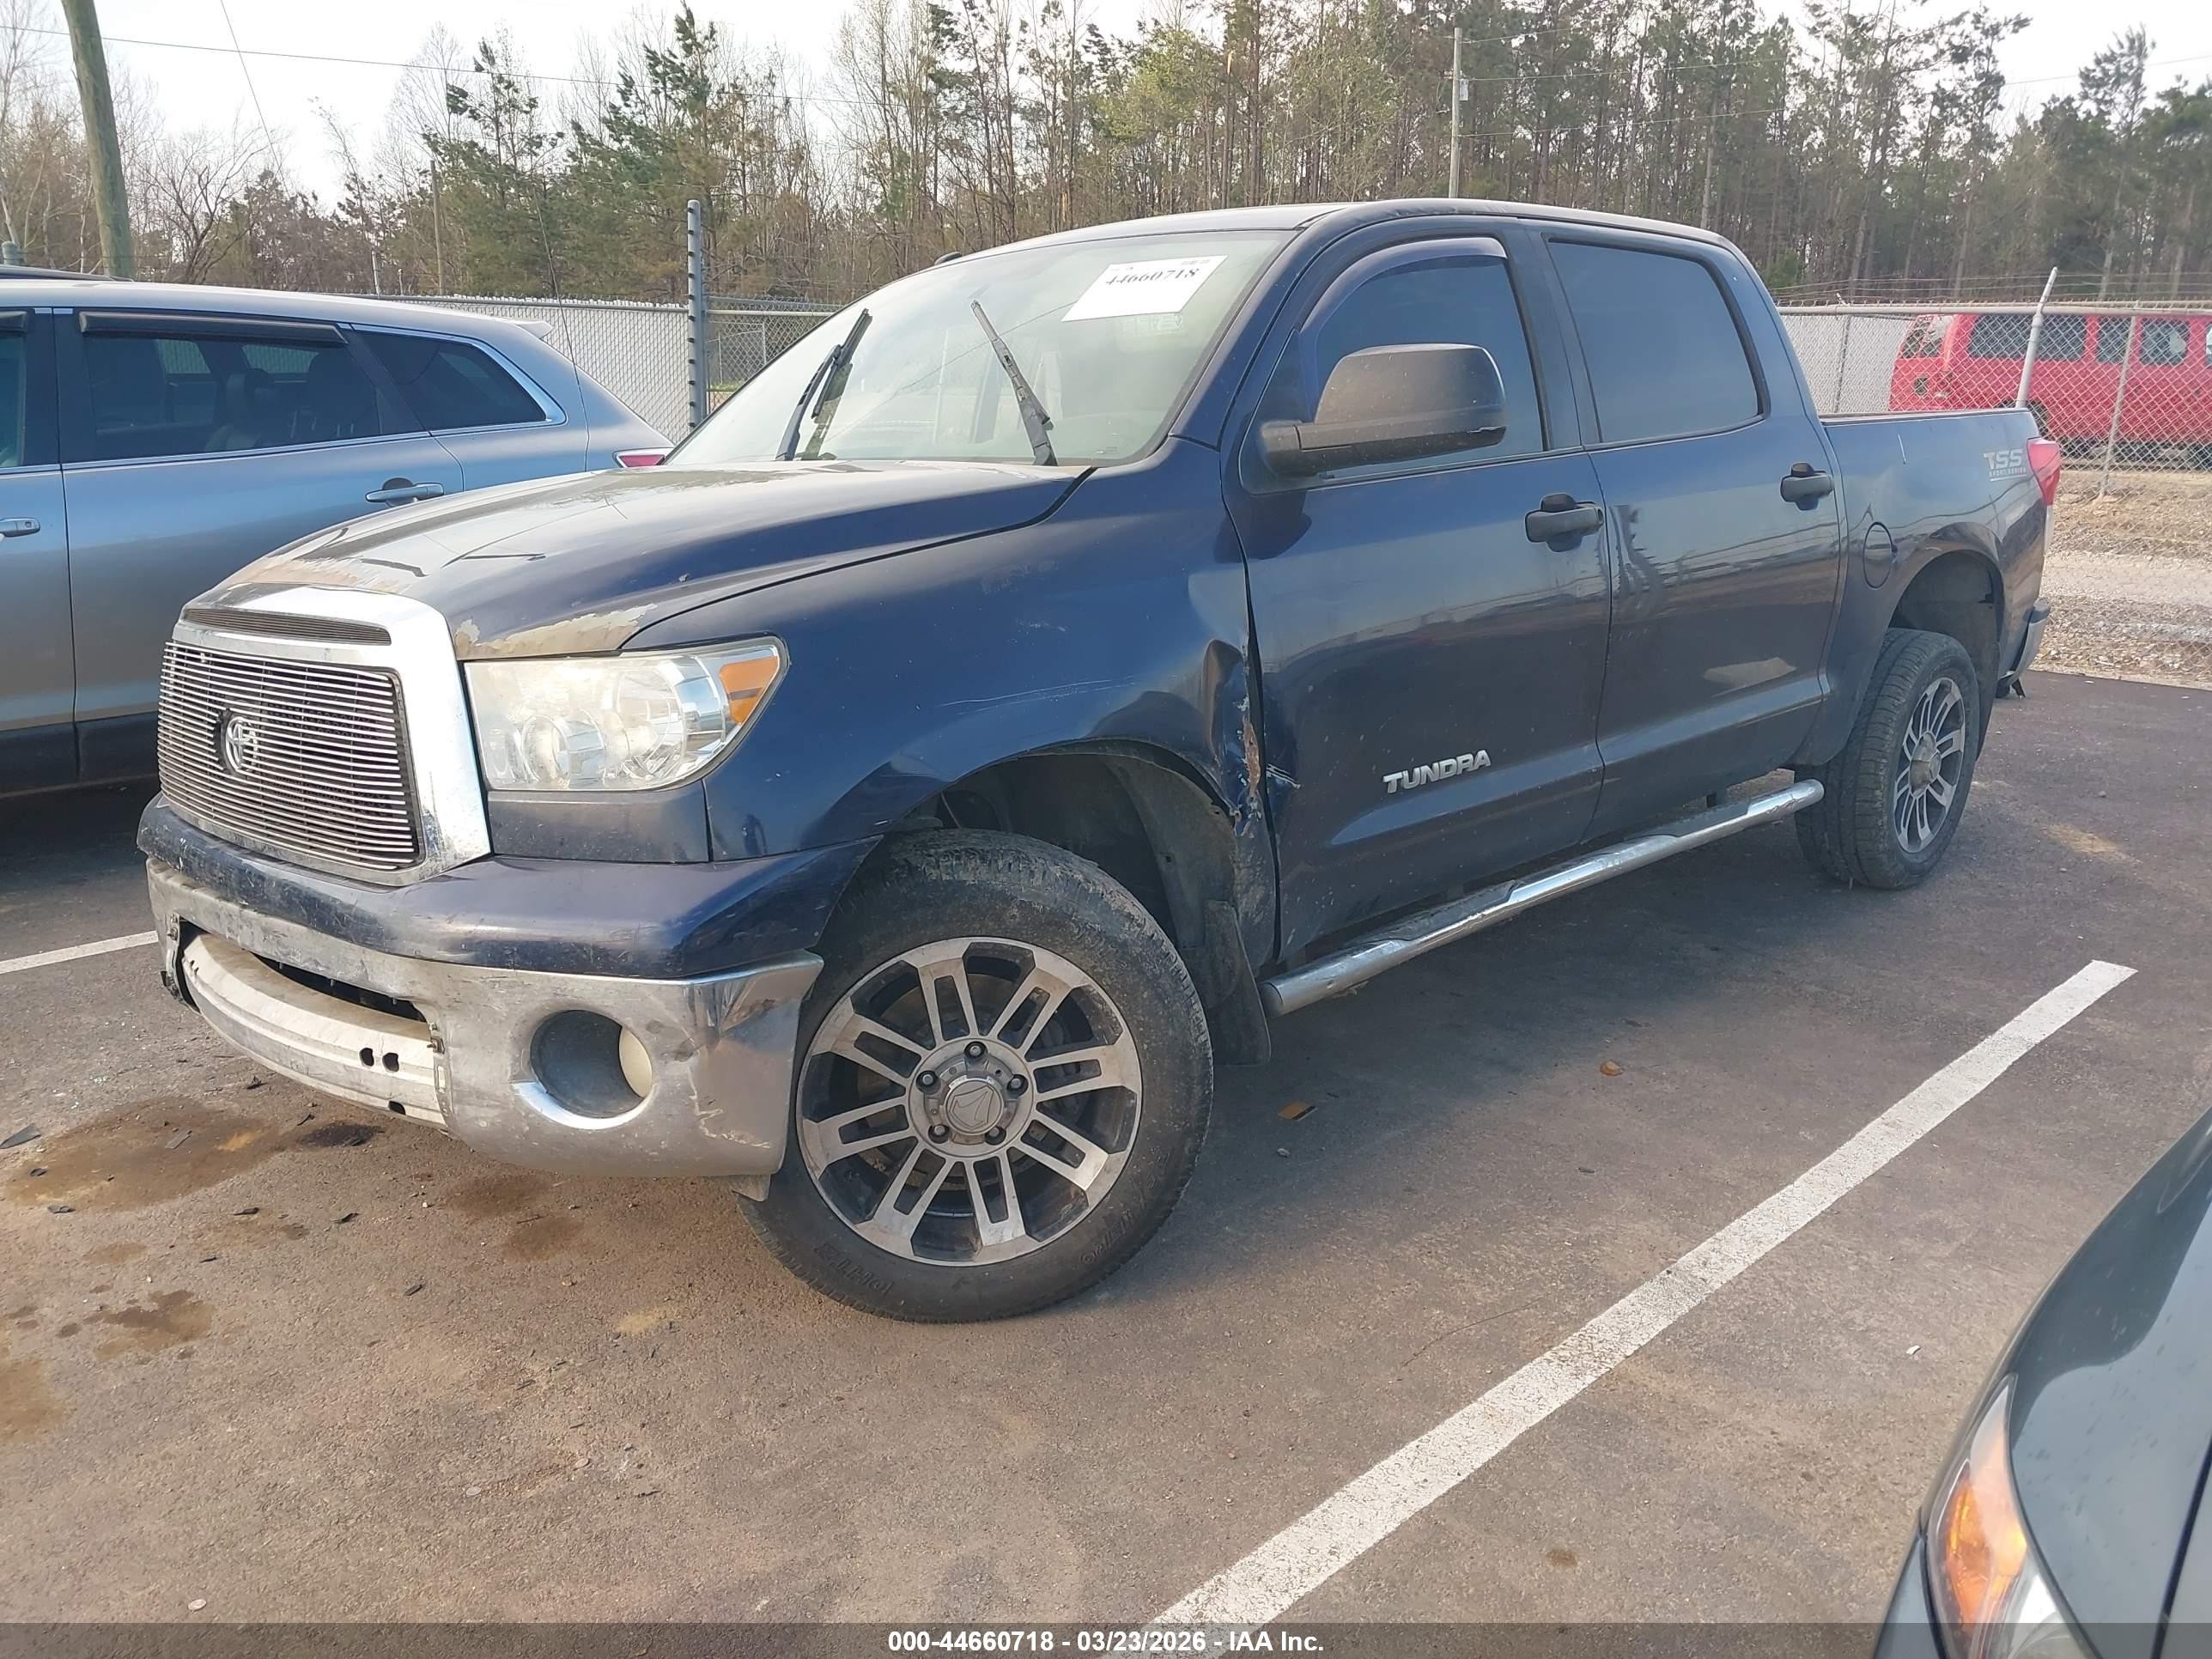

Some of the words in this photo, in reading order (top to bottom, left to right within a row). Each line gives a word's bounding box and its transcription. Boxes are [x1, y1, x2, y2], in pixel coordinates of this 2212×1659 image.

[1106, 268, 1200, 285] 44660718
[1983, 448, 2023, 470] TSS
[1382, 749, 1492, 793] TUNDRA
